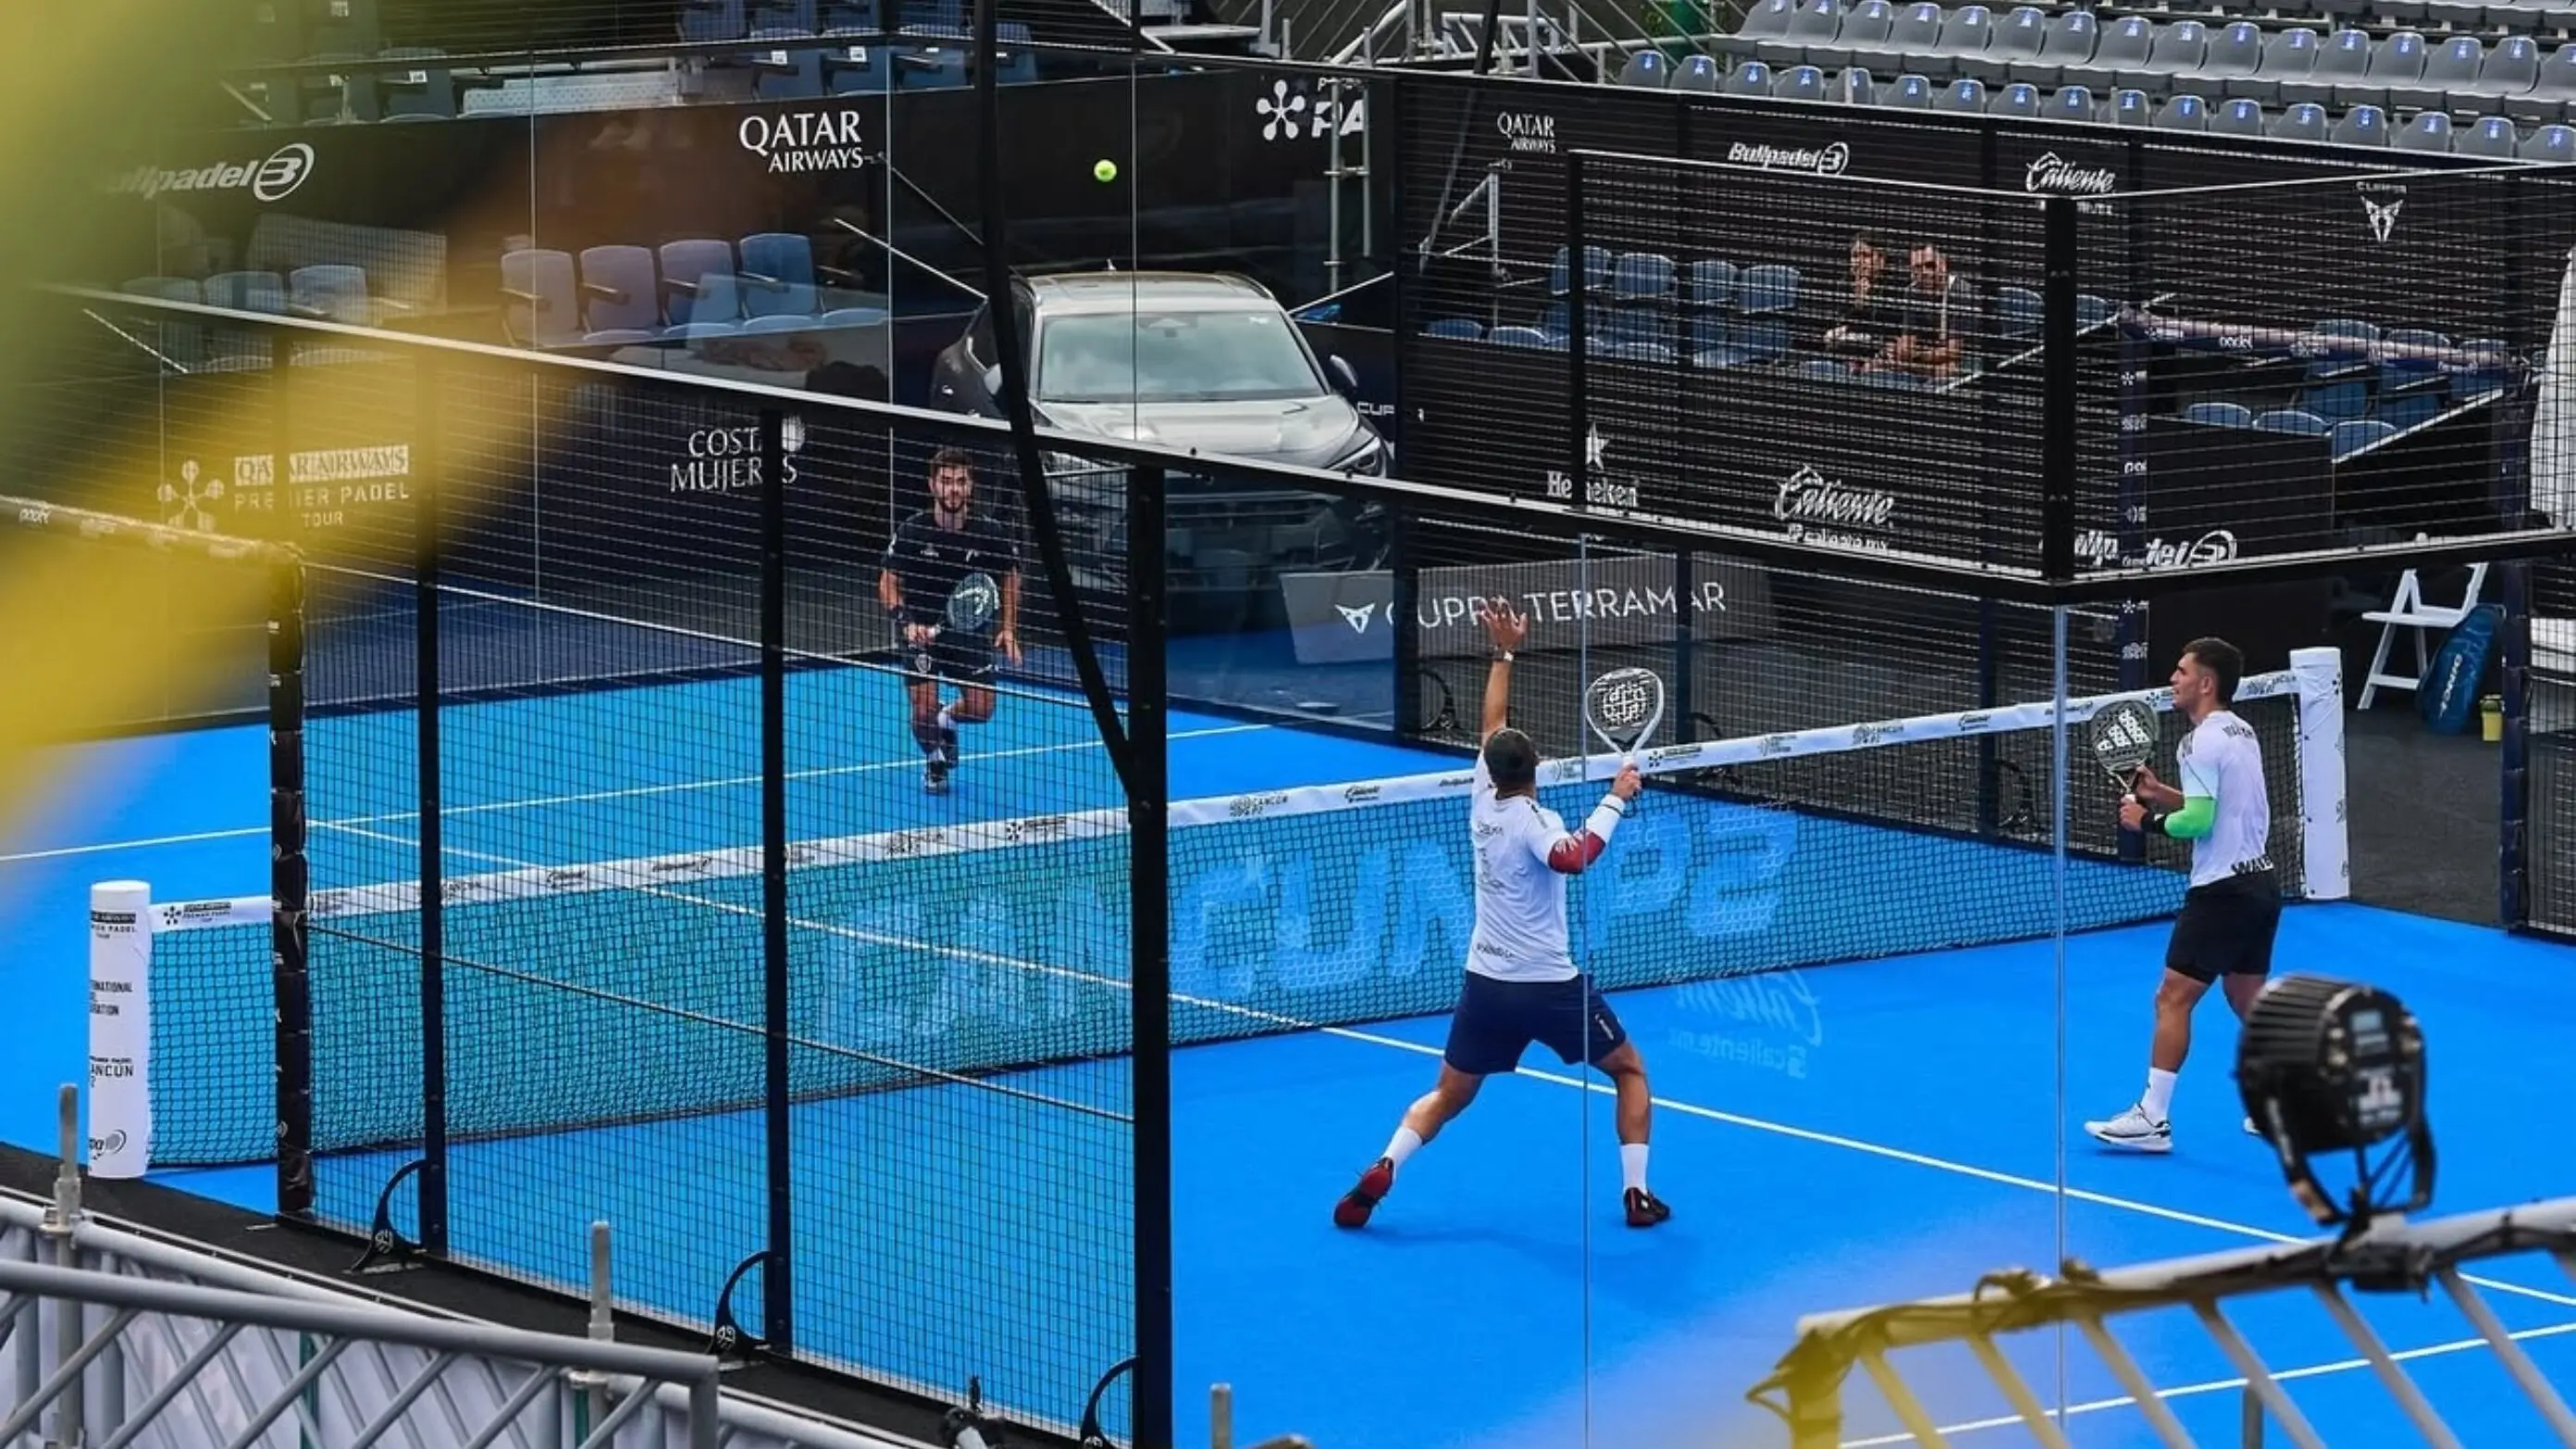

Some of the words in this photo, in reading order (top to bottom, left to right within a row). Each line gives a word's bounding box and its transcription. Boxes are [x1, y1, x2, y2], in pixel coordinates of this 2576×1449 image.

[739, 109, 862, 155] QATAR
[1497, 111, 1555, 140] QATAR
[768, 146, 864, 174] AIRWAYS
[104, 159, 259, 201] ullpadel
[687, 426, 762, 458] COST
[237, 452, 310, 484] QAR
[316, 448, 408, 476] AIRWAYS
[670, 452, 799, 494] MUJERS
[235, 487, 328, 511] PREIER
[341, 481, 409, 503] PADEL
[1546, 470, 1639, 508] Heeken
[303, 511, 343, 527] TOUR
[2038, 529, 2190, 567] ullpdel
[1385, 594, 1516, 629] UPR
